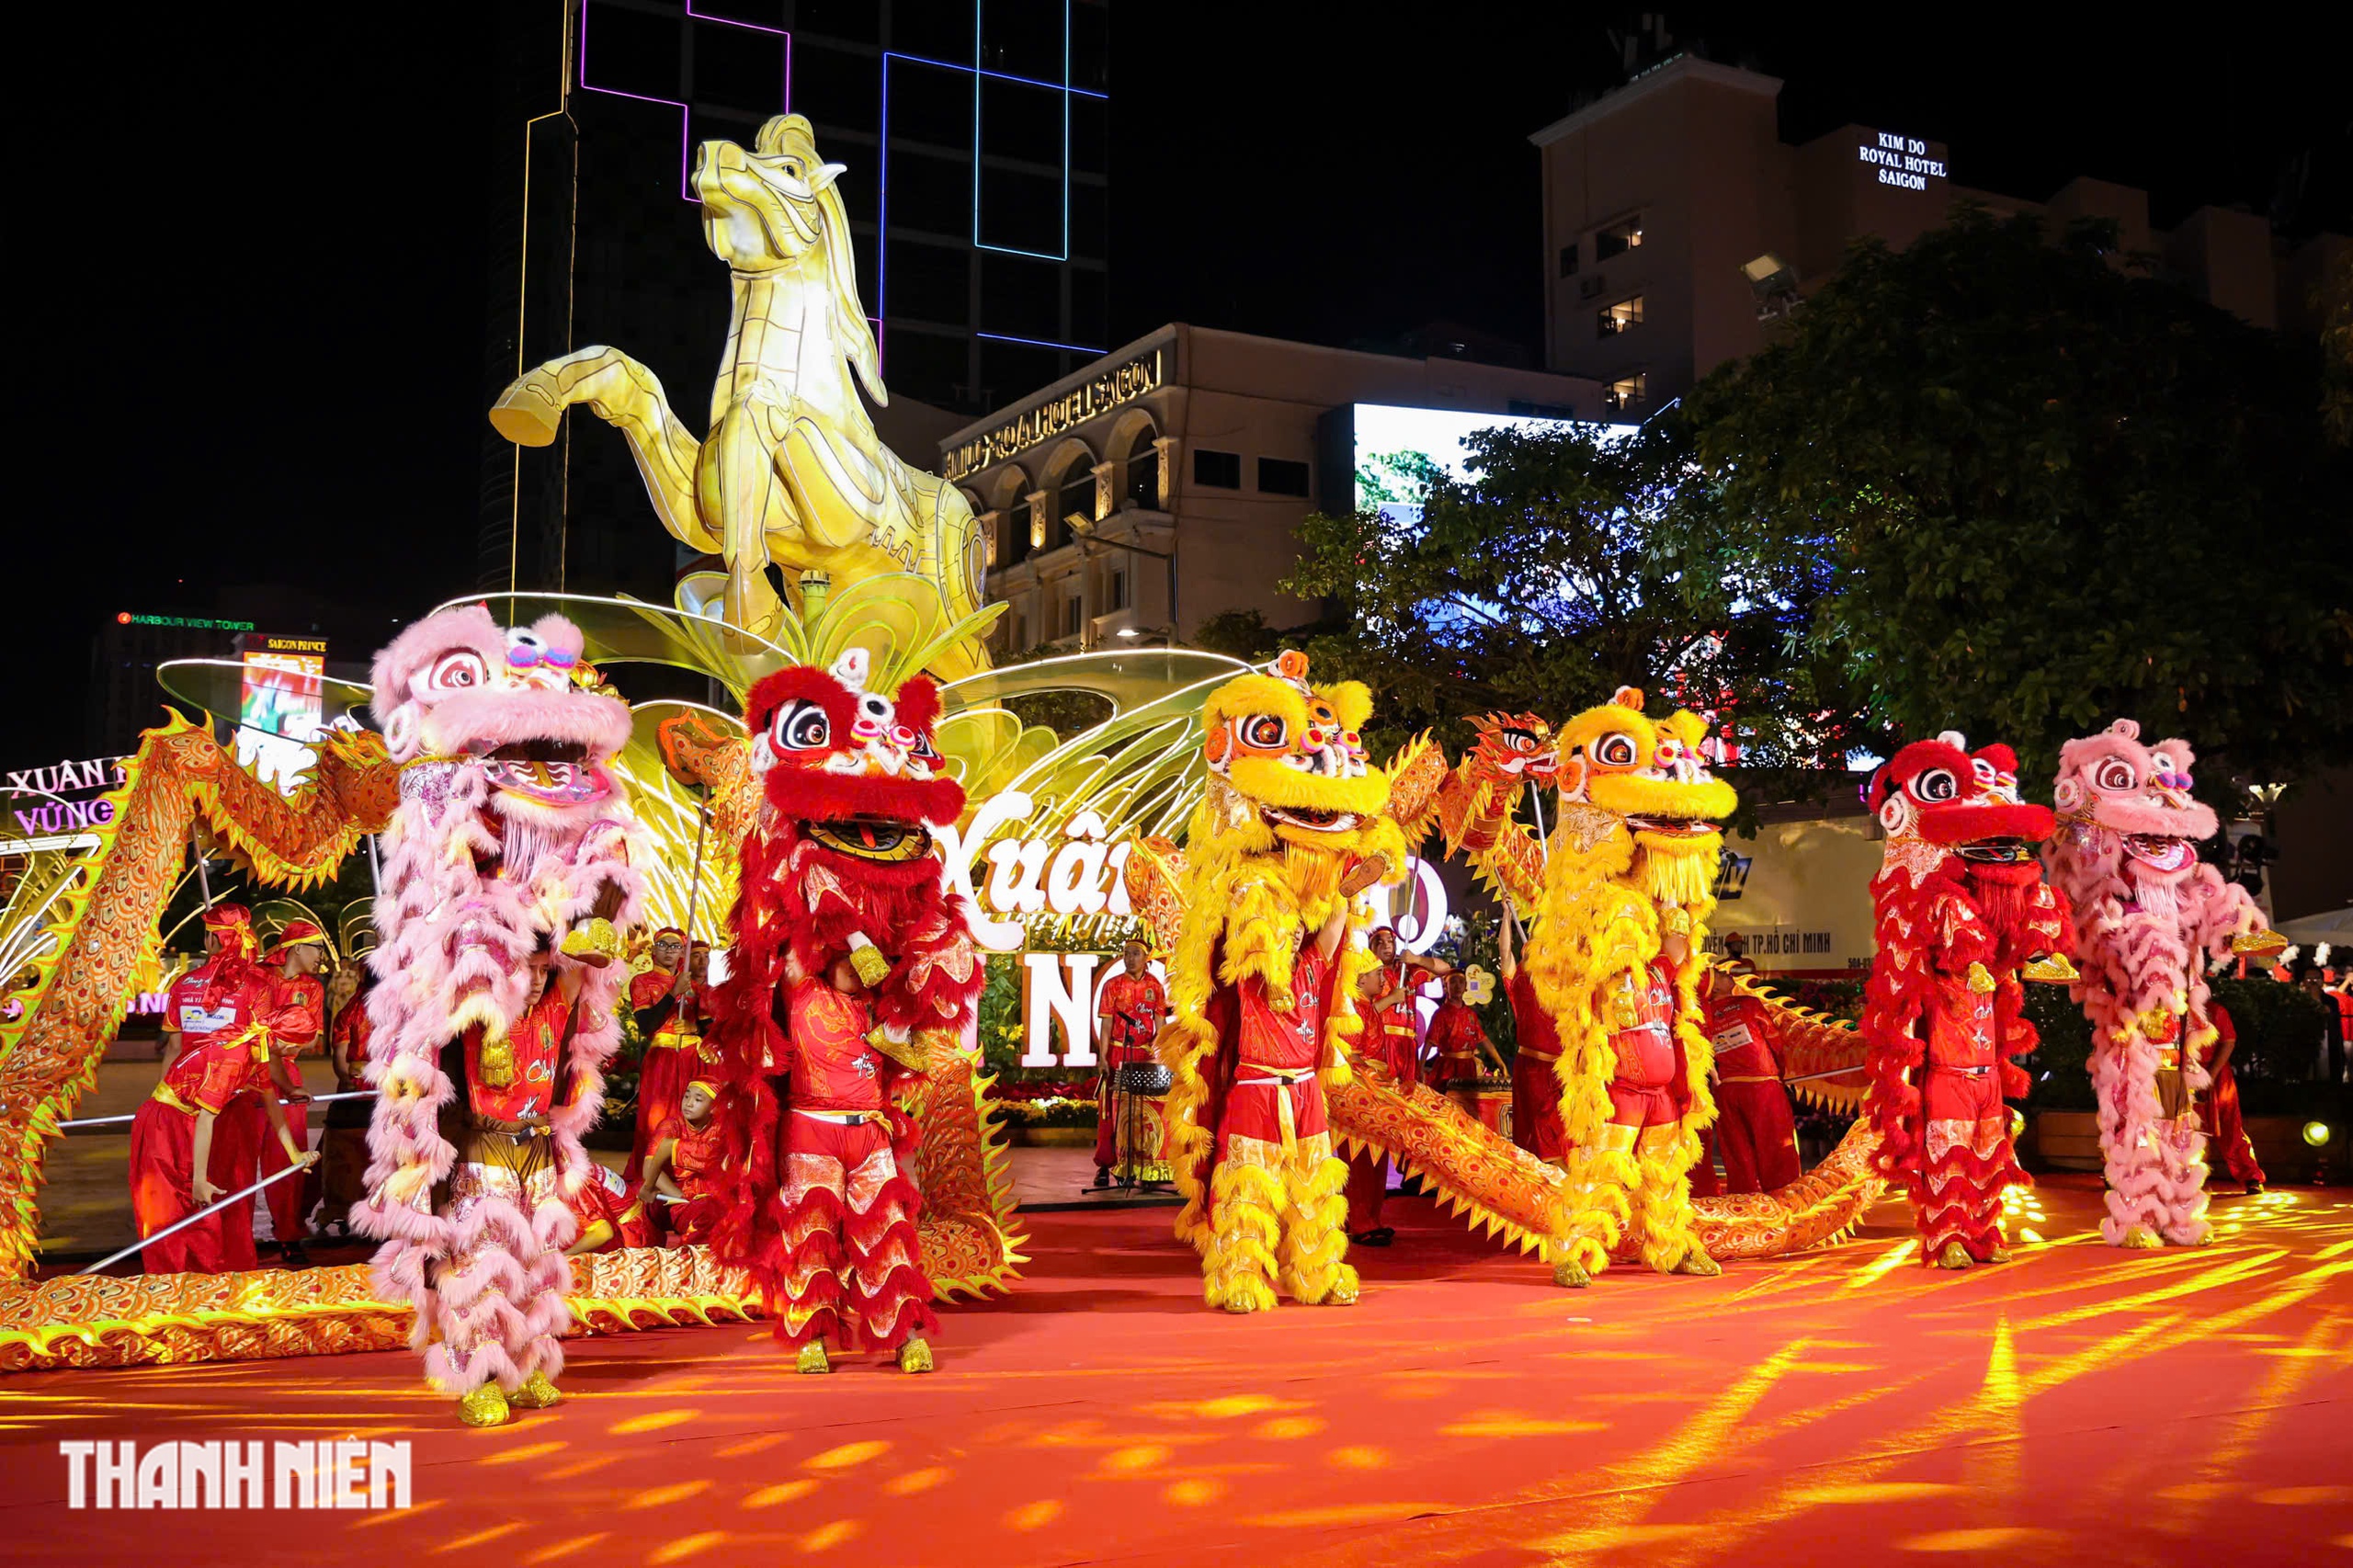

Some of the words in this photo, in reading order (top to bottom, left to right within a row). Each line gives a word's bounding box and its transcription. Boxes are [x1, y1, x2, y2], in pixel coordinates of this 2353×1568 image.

[1878, 132, 1904, 151] KIM
[1908, 139, 1926, 155] DO
[1859, 146, 1902, 168] ROYAL
[1904, 156, 1947, 177] HOTEL
[1878, 169, 1926, 190] SAIGON
[131, 614, 184, 627] HARBOUR
[187, 619, 213, 629] VIEW
[216, 619, 255, 631] TOWER
[267, 639, 298, 650] SAIGON
[298, 640, 326, 652] PRINCE
[7, 759, 107, 799] XUÂN
[14, 799, 115, 835] VỮNG
[1783, 929, 1800, 953] CHÍ
[1803, 932, 1831, 953] MINH
